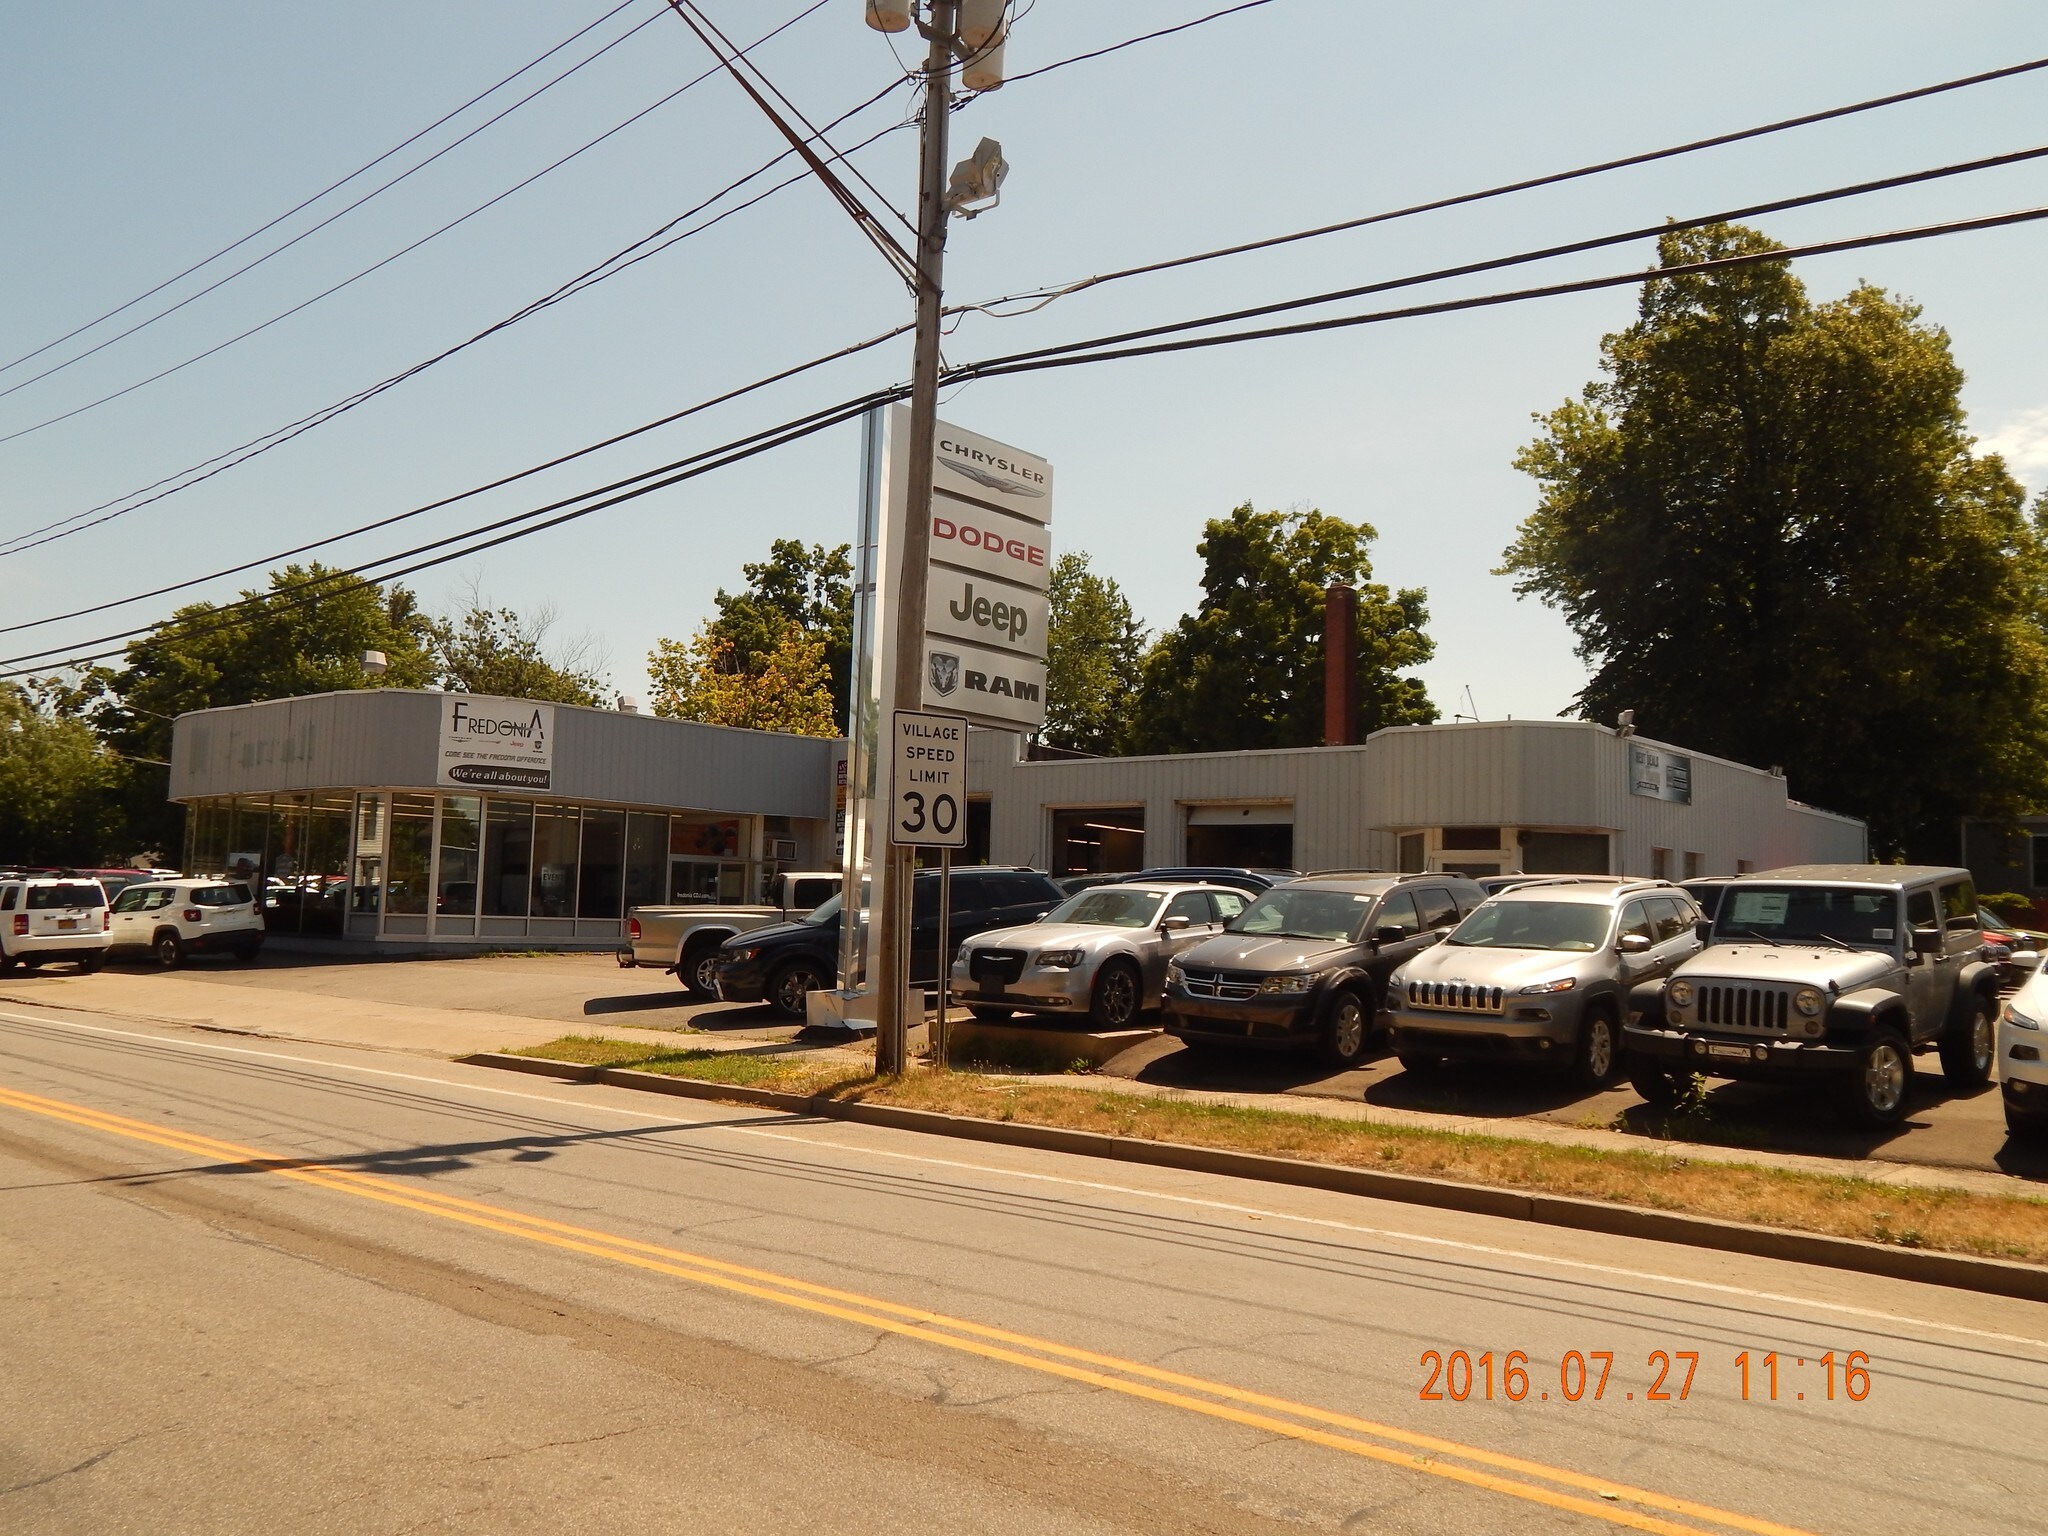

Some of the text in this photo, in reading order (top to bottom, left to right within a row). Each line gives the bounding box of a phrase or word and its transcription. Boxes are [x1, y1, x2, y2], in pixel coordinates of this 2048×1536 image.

[939, 440, 1044, 484] CHRYSLER
[933, 517, 1044, 567] DODGE
[949, 582, 1028, 642] Jeep
[964, 669, 1040, 703] RAM
[452, 702, 545, 740] FREDONIA
[902, 723, 959, 741] VILLAGE
[444, 750, 462, 758] COME
[462, 751, 475, 759] SEE
[476, 752, 488, 760] THE
[906, 746, 955, 762] SPEED
[451, 768, 548, 785] We're all about you!
[909, 768, 950, 784] LIMIT
[901, 791, 957, 835] 30
